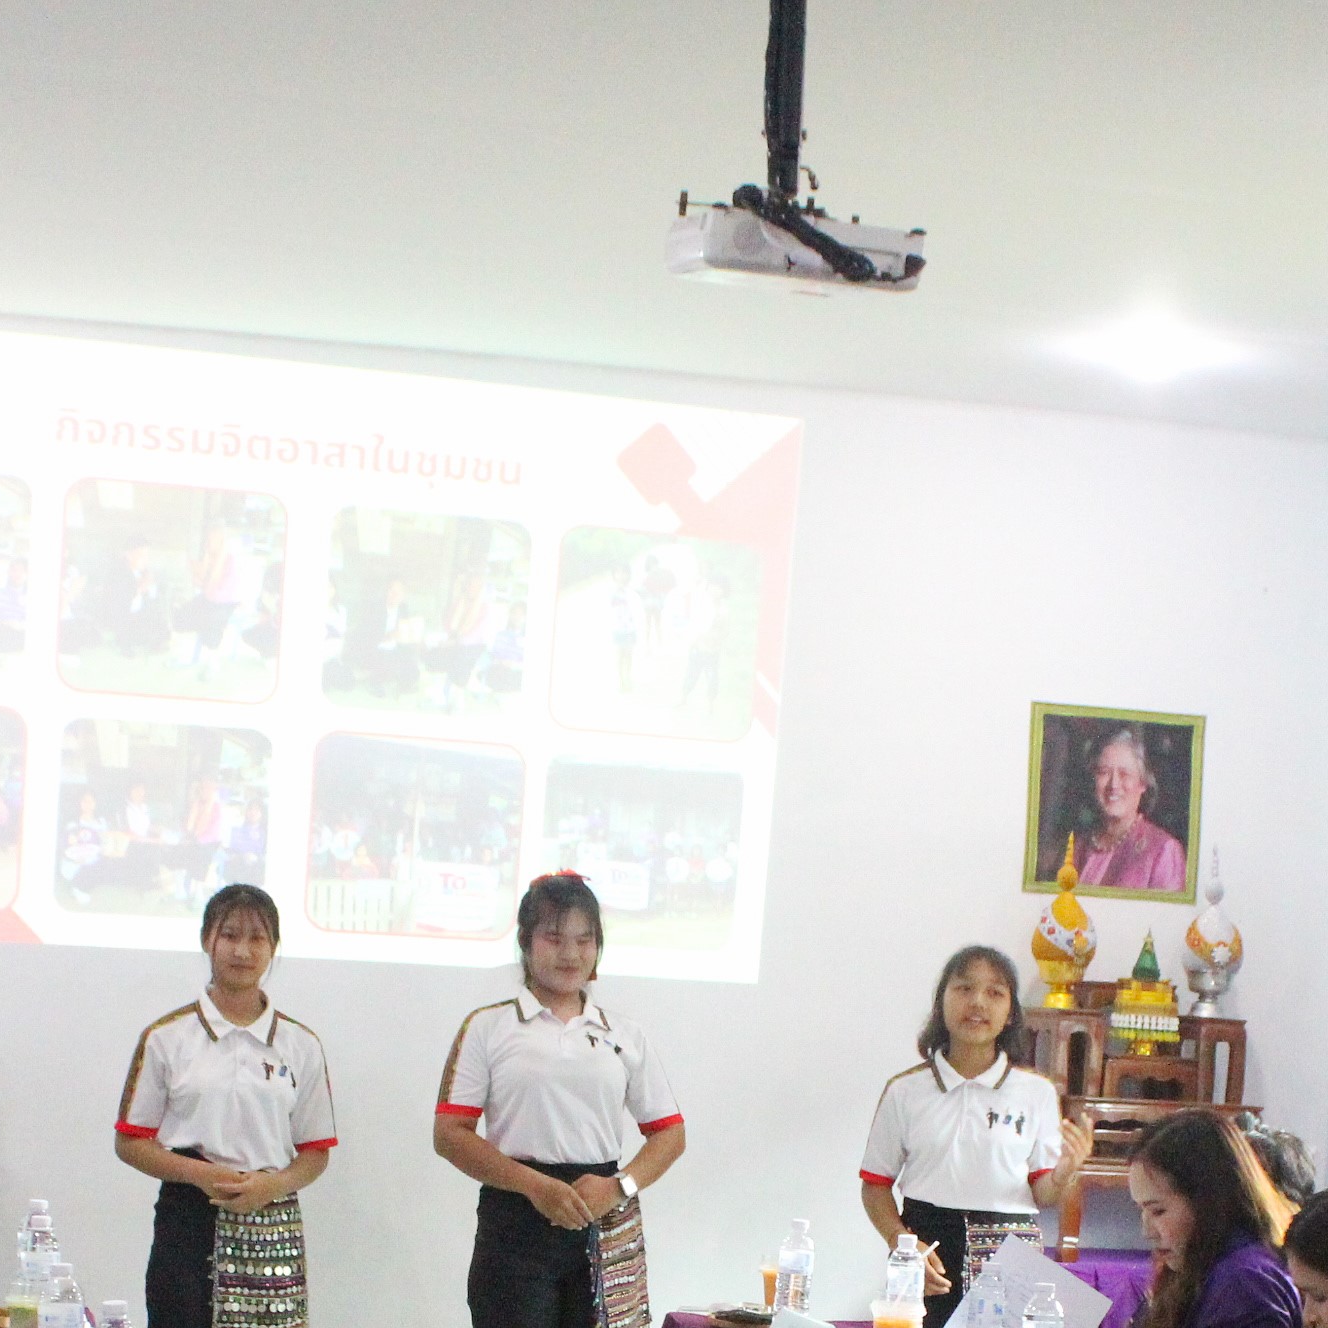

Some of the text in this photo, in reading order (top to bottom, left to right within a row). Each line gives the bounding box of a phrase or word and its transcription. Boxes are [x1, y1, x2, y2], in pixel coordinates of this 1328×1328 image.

[55, 408, 522, 489] กิจกรรมจิตอาสาในชุมชน
